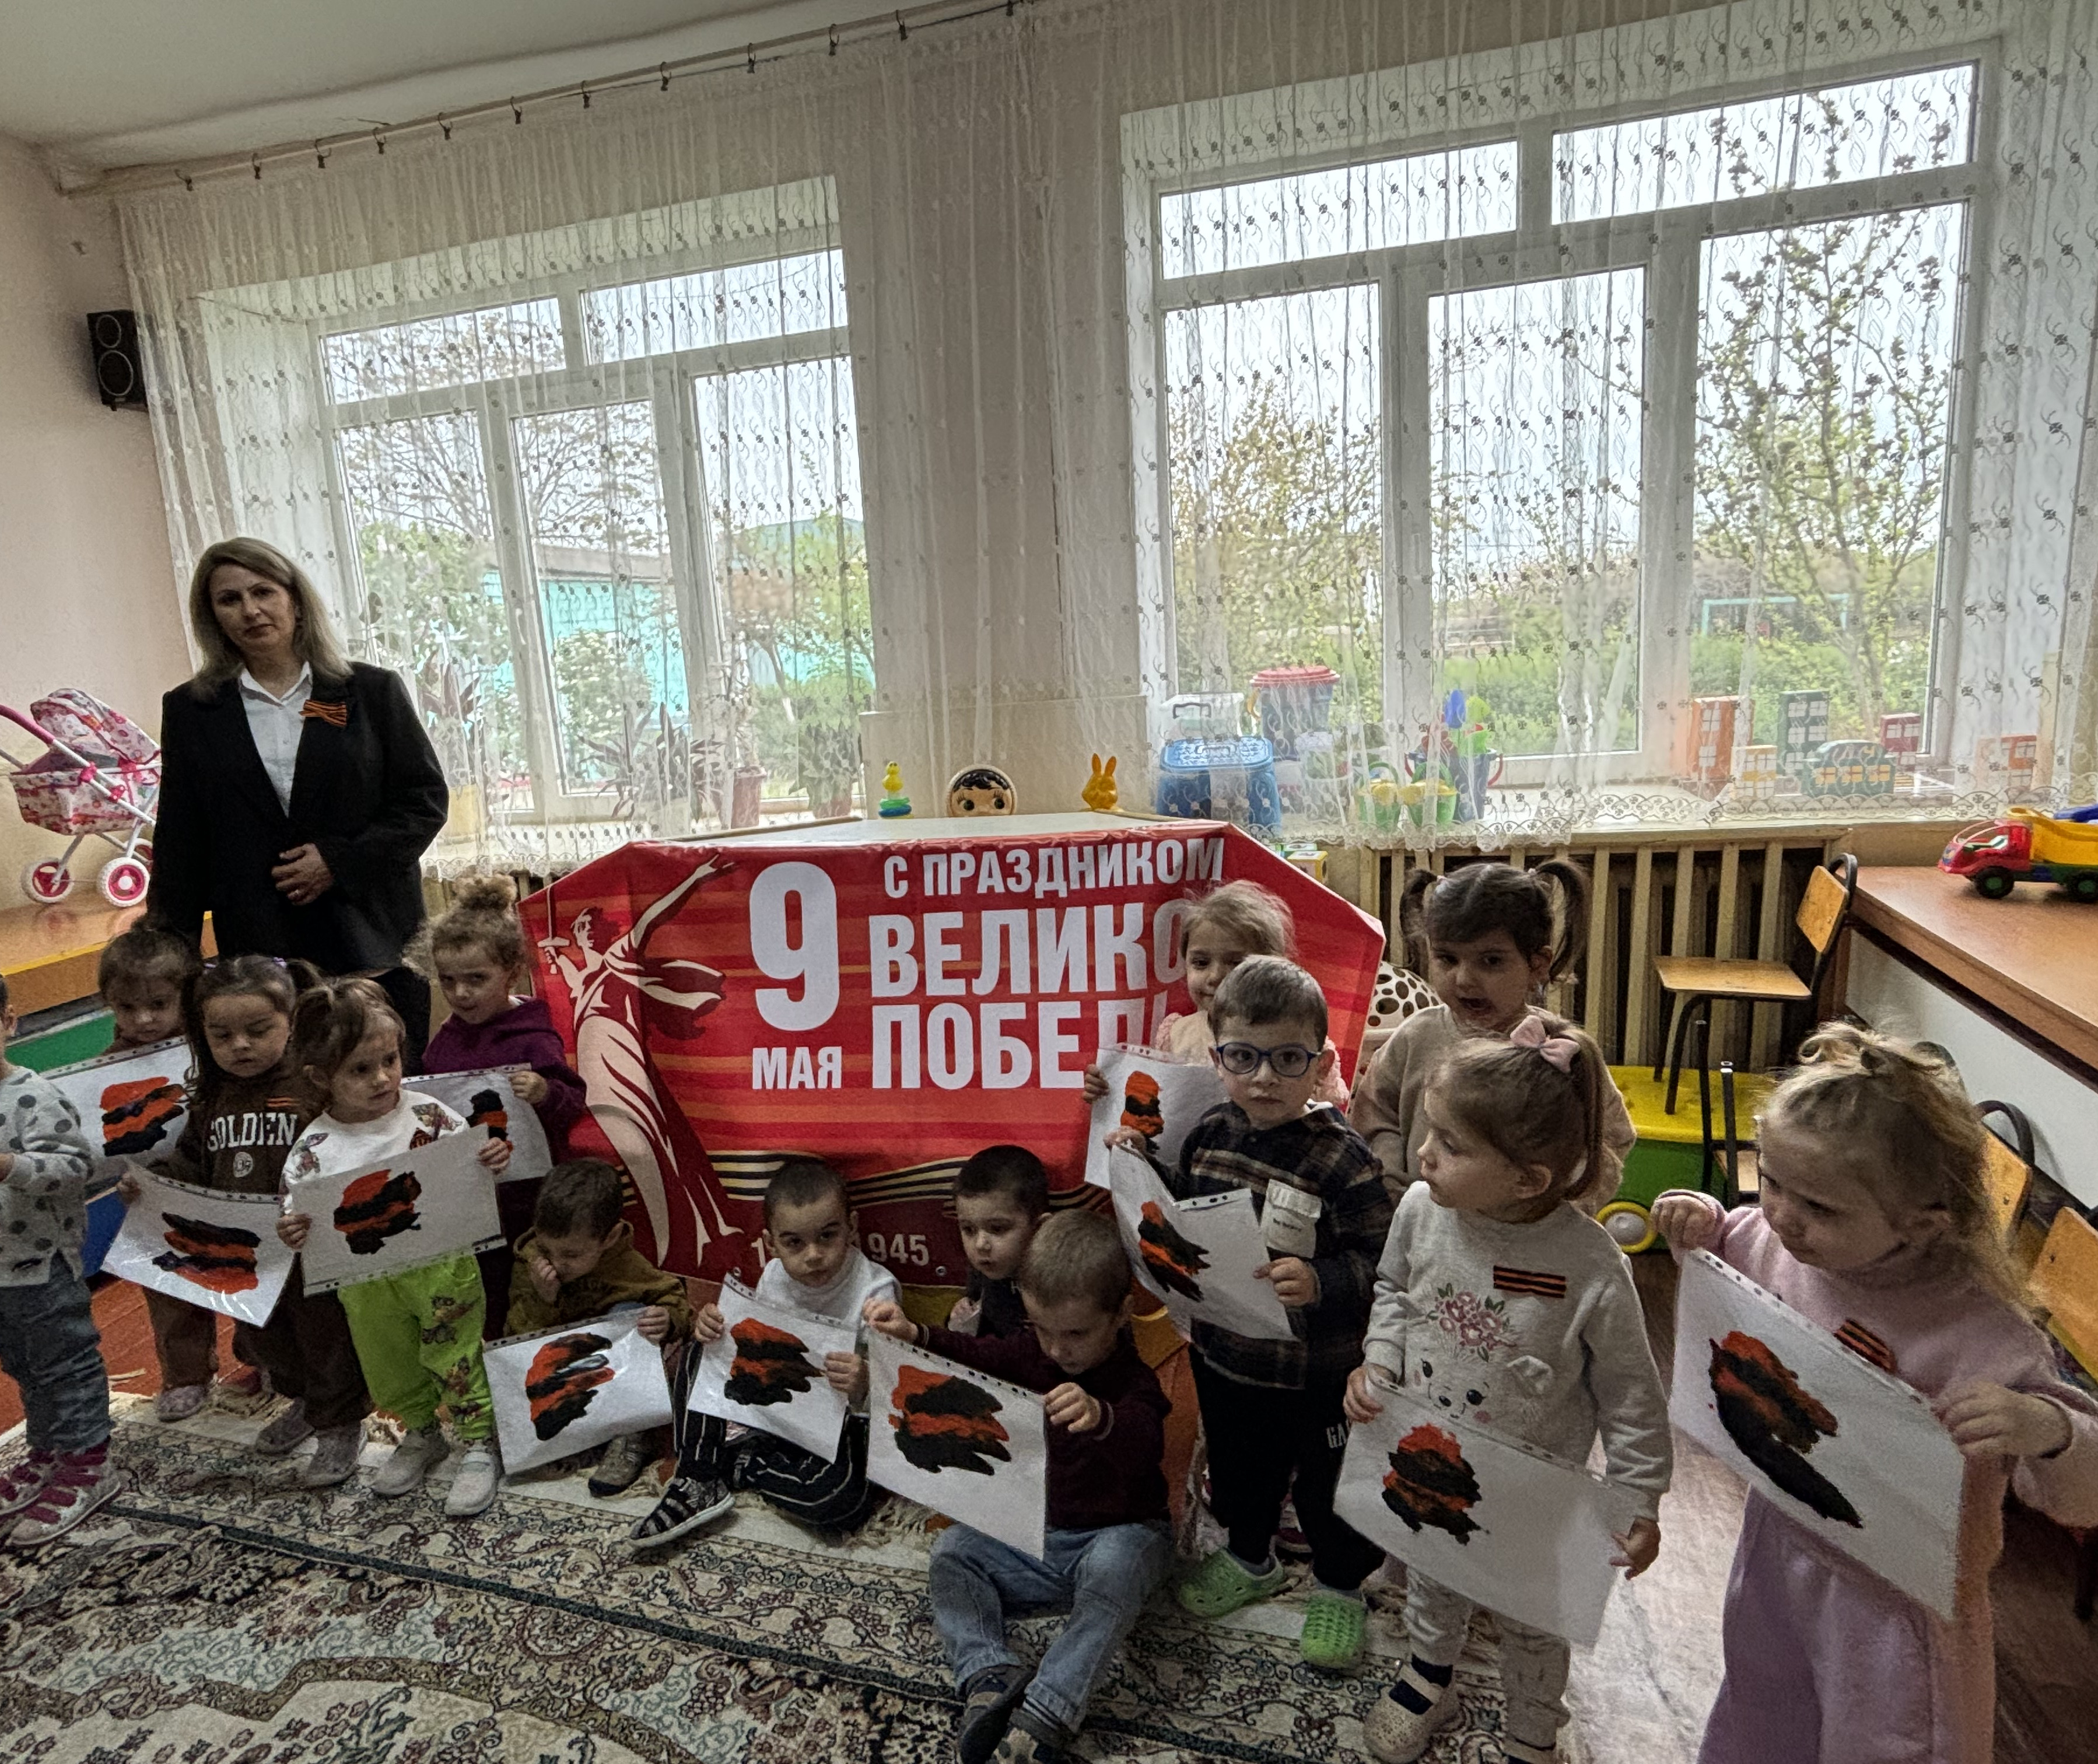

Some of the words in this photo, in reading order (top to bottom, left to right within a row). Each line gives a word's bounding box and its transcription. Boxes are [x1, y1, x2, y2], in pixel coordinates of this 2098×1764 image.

[884, 855, 908, 899] С
[923, 838, 1224, 899] ПРАЗДНИКОМ
[748, 861, 840, 1031] 9
[869, 899, 1188, 998] ВЕЛИКО
[752, 1046, 843, 1090] МАЯ
[871, 991, 1168, 1090] ПОБЕ
